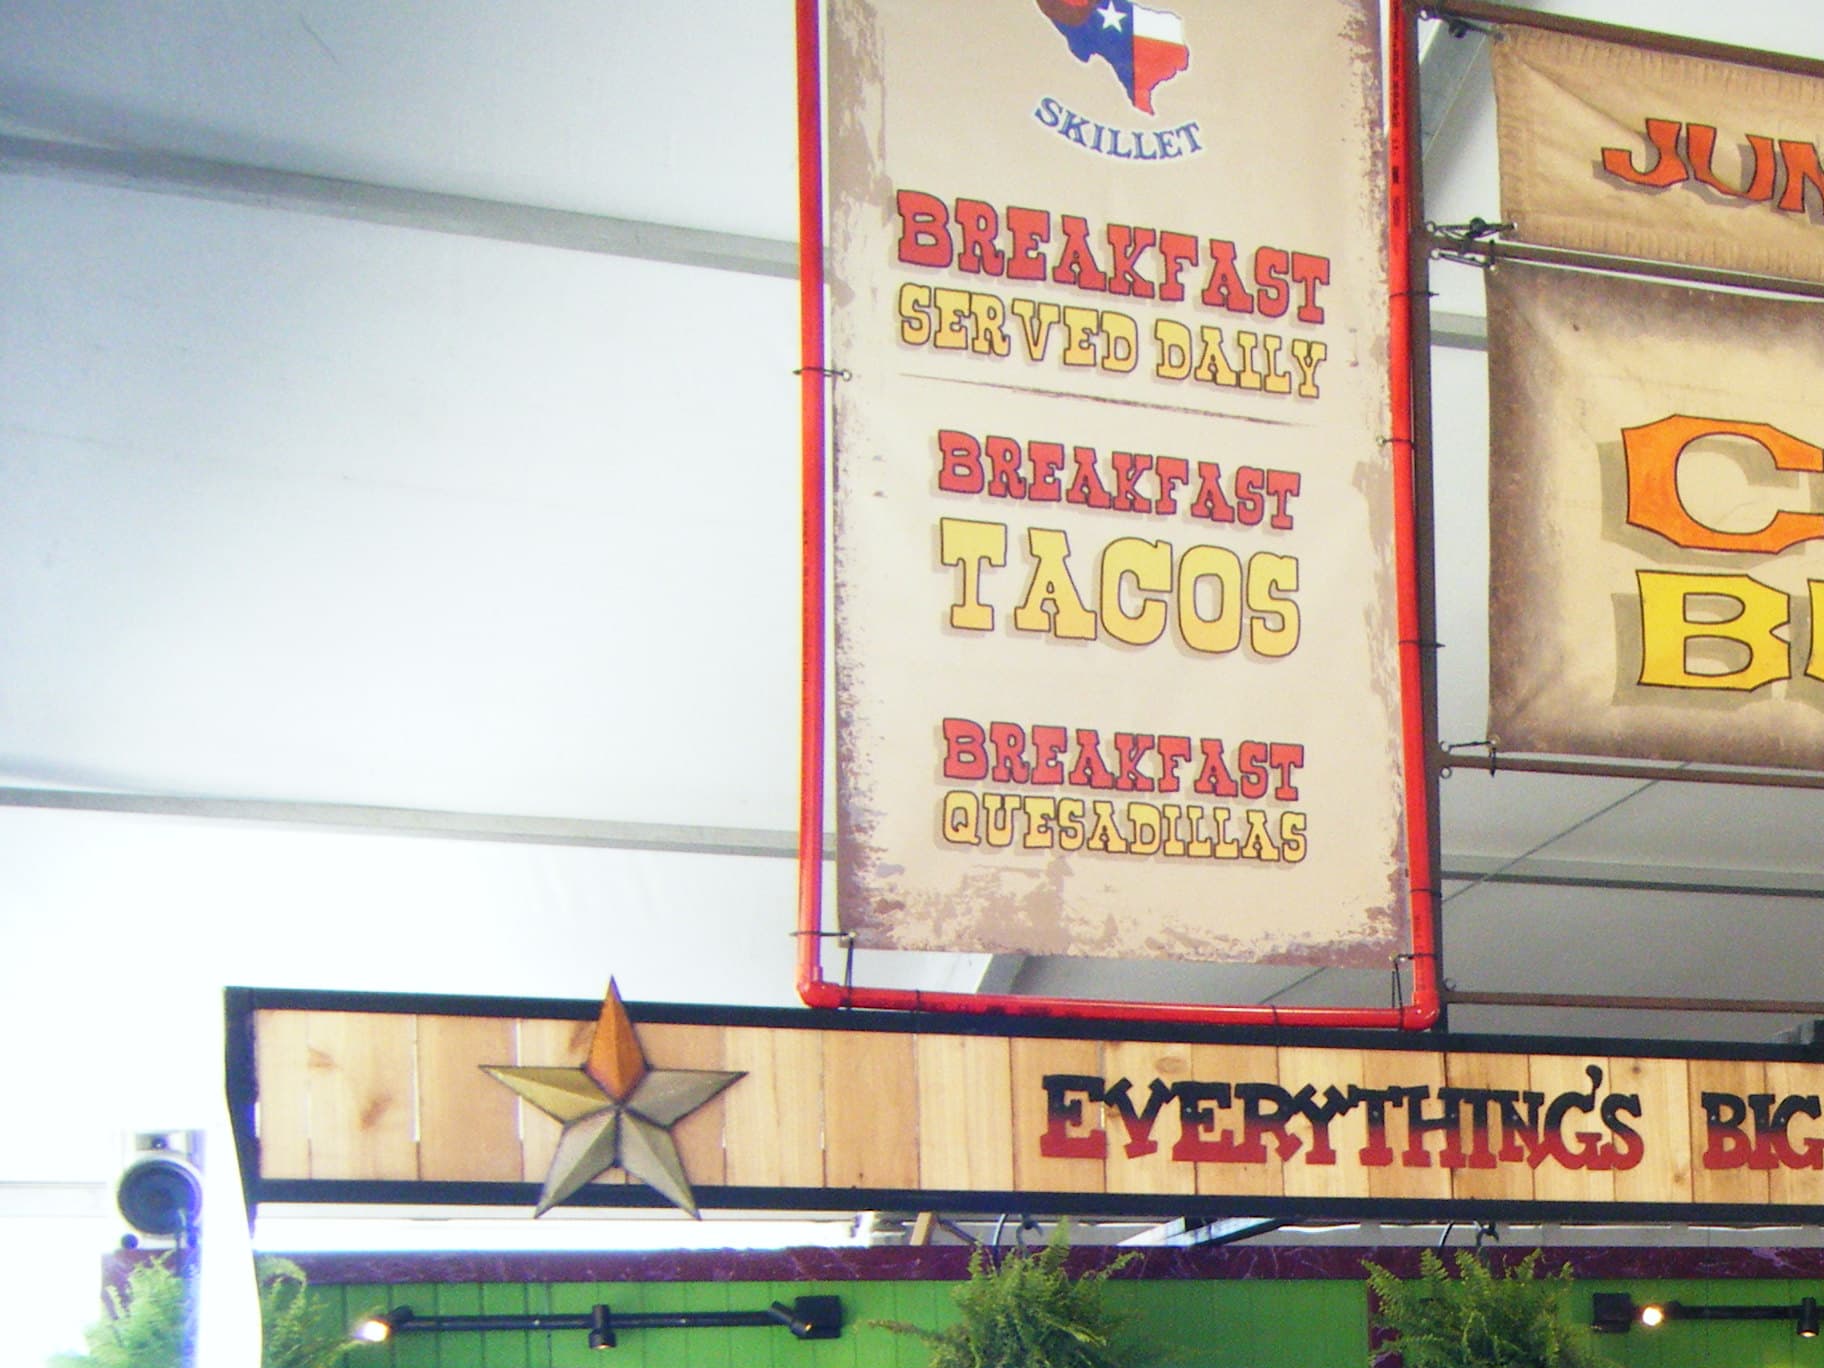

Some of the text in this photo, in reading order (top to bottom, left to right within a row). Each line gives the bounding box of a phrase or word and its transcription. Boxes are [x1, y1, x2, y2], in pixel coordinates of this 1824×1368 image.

[1034, 96, 1204, 161] SKILLET
[896, 189, 1331, 325] BREAKFAST
[898, 283, 1328, 399] SERVED DAILY
[937, 429, 1301, 531] BREAKFAST
[939, 516, 1300, 658] TACOS
[942, 717, 1305, 802] BREAKFAST
[942, 790, 1308, 864] QUESADILLAS
[1039, 1064, 1646, 1172] EVERYTHING'S
